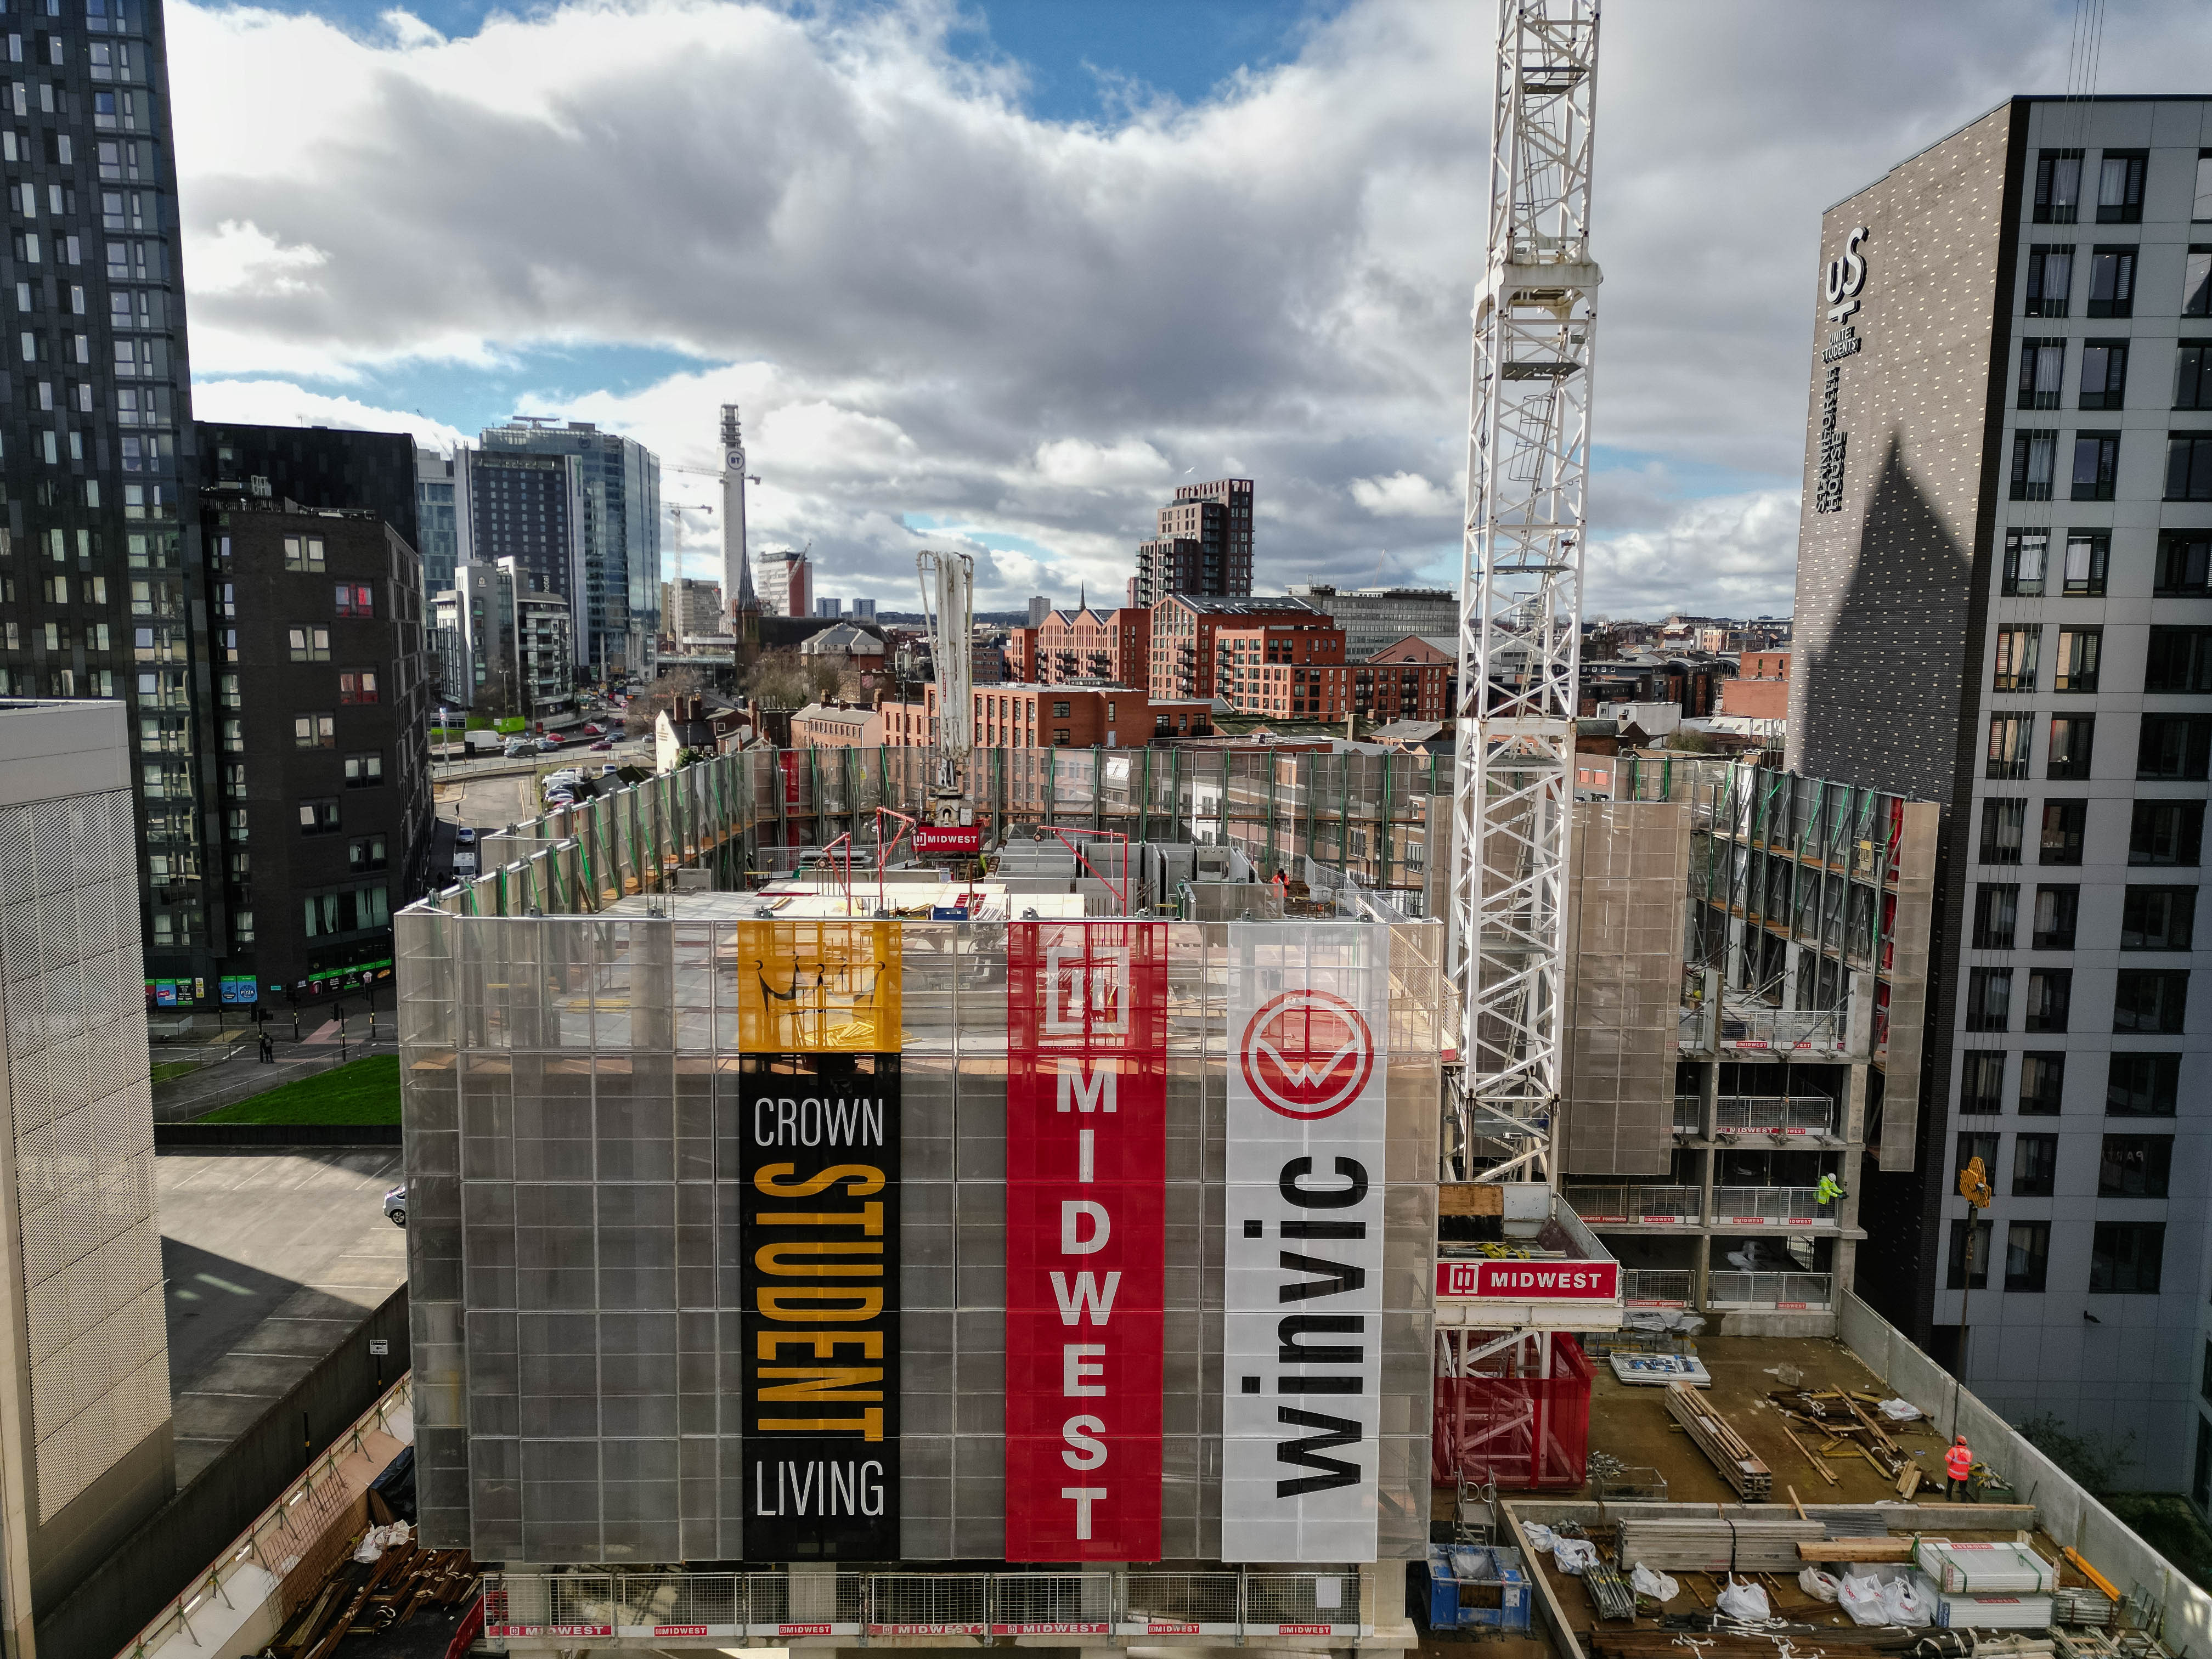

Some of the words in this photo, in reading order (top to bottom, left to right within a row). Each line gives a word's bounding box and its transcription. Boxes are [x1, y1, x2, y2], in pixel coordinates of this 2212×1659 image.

[1821, 337, 1857, 362] STUDENTS
[1829, 326, 1849, 345] UNITE
[1815, 366, 1838, 514] STANIFORTH
[1825, 431, 1845, 513] HOUSE
[754, 1098, 884, 1147] CROWN
[755, 1163, 885, 1442] STUDENT
[1050, 1057, 1122, 1540] MIDWEST
[1491, 1272, 1601, 1289] MIDWEST
[1242, 1155, 1368, 1499] winvic
[756, 1460, 885, 1516] LIVING
[526, 1626, 603, 1635] MDWEST
[898, 1625, 974, 1634] MIDWEST
[1023, 1624, 1099, 1633] MIDWEST
